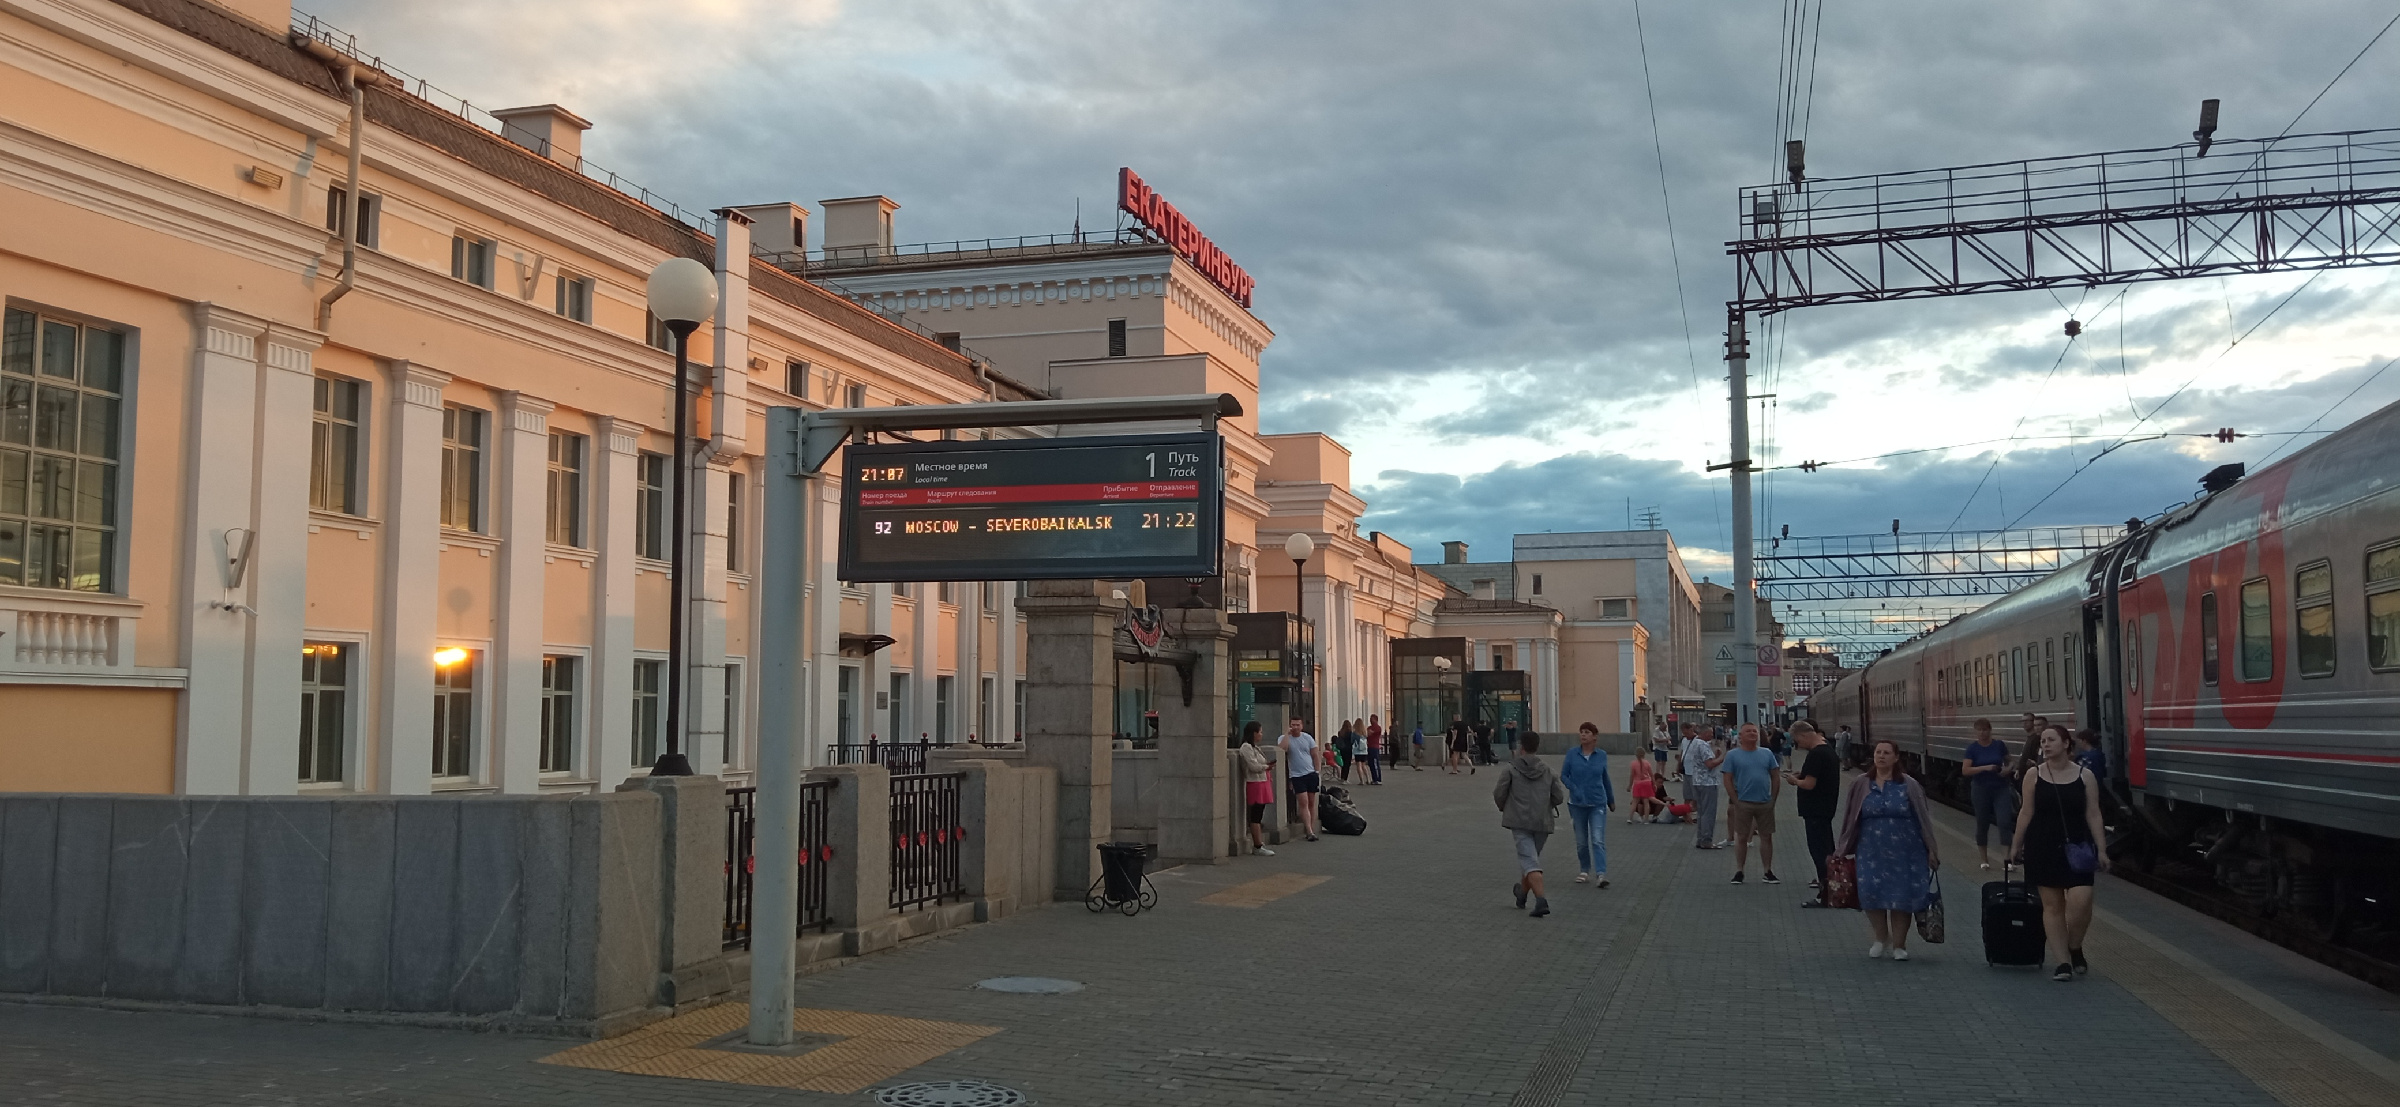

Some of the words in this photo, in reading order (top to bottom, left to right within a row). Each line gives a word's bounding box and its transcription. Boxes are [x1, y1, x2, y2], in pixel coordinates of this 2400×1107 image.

[1119, 167, 1256, 308] ЕКАТЕРИНБУРГ
[1168, 451, 1200, 466] Путь
[915, 463, 956, 472] Местное
[958, 462, 988, 473] время
[1145, 452, 1156, 478] 1
[861, 468, 905, 481] 21:07
[1169, 466, 1197, 477] Track
[915, 475, 933, 484] Local
[933, 475, 948, 483] time
[1103, 485, 1139, 493] Прибытие
[1149, 483, 1196, 492] Отправление
[862, 491, 884, 499] Номер
[927, 490, 957, 499] Маршрут
[958, 489, 997, 497] следования
[875, 521, 892, 535] 92
[905, 520, 959, 534] MOSCOW
[986, 516, 1113, 533] SEVEROBAIKALSK
[1141, 512, 1195, 529] 21:22
